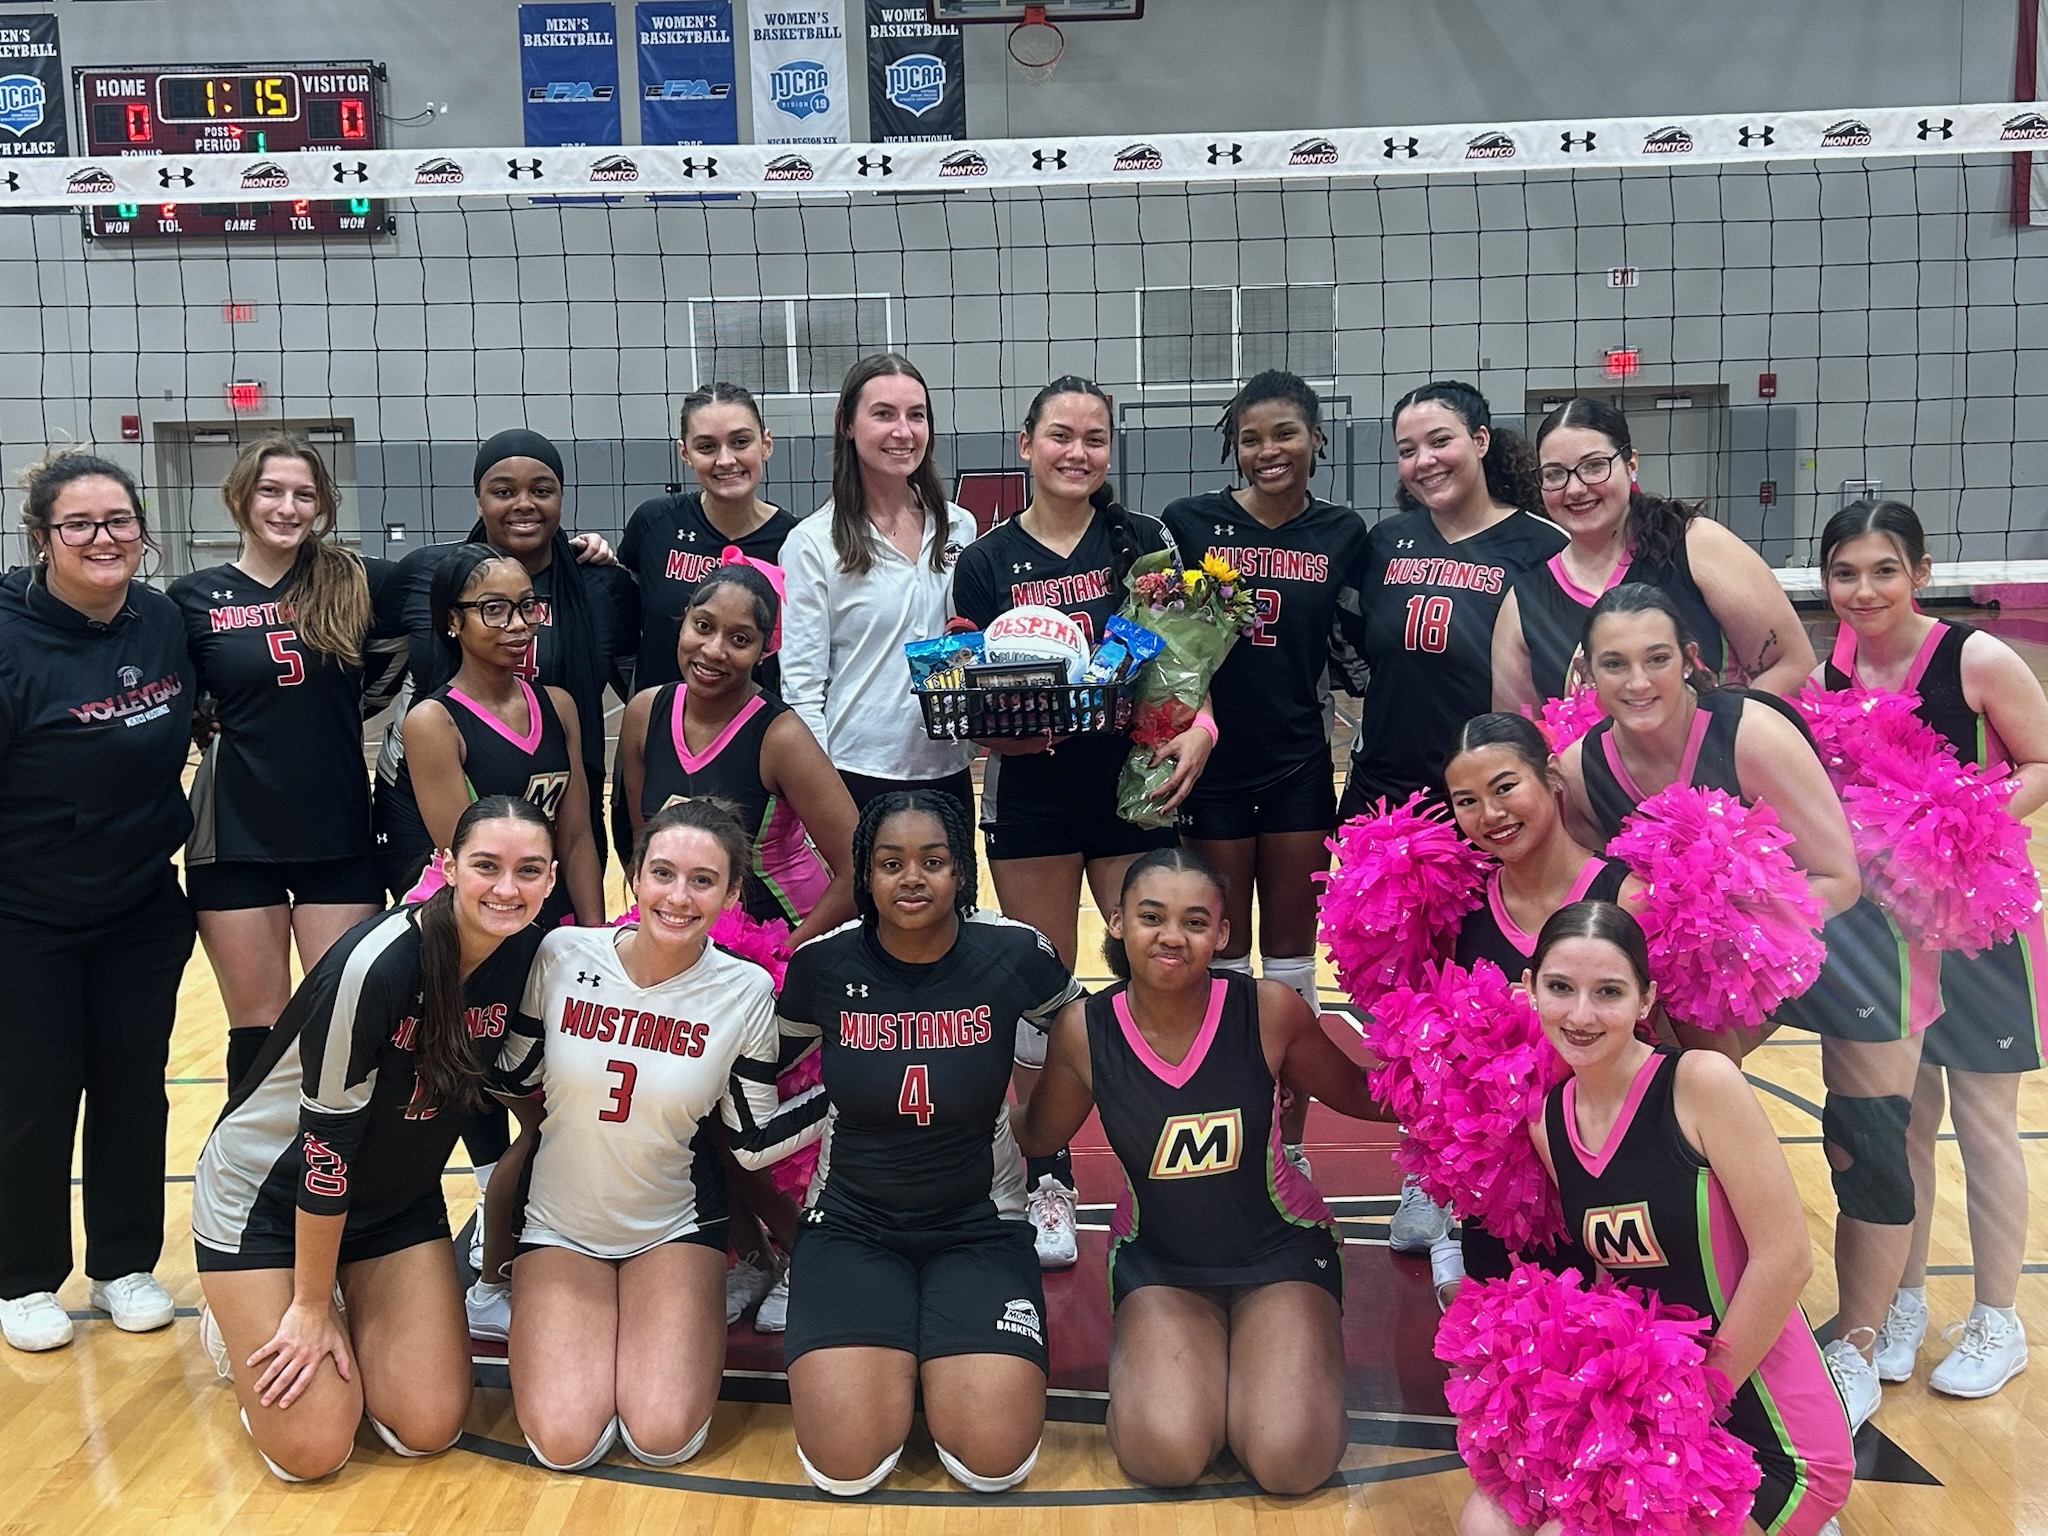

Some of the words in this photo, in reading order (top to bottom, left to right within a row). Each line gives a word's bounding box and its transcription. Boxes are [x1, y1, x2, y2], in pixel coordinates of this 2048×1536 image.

[652, 15, 717, 29] WOMEN'S
[765, 12, 829, 25] WOMEN'S
[881, 8, 928, 22] WOME
[546, 19, 589, 31] MEN'S
[870, 24, 959, 38] BASKETBALL
[524, 33, 613, 46] BASKETBALL
[641, 30, 730, 44] BASKETBALL
[754, 27, 842, 40] BASKETBALL
[96, 79, 146, 97] HOME
[302, 75, 369, 93] VISITOR
[770, 71, 828, 100] NJCAA
[888, 66, 944, 95] NJCAA
[528, 82, 615, 100] EPAC
[645, 80, 731, 99] EPAC
[206, 79, 288, 117] 1:15
[814, 99, 827, 109] 19
[126, 103, 151, 142] 0
[340, 100, 365, 138] 0
[204, 127, 229, 137] POSS
[194, 138, 241, 152] PERIOD
[1642, 139, 1694, 154] MONTCO
[1820, 132, 1871, 148] MONTCO
[13, 142, 56, 154] PLACE
[1465, 145, 1516, 160] MONTCO
[1113, 157, 1163, 171] MONTCO
[1288, 152, 1339, 166] MONTCO
[414, 170, 464, 184] MONTCO
[589, 168, 639, 182] MONTCO
[764, 168, 814, 181] MONTCO
[938, 163, 988, 177] MONTCO
[66, 181, 115, 194] MONTCO
[241, 177, 289, 189] MONTCO
[105, 222, 130, 233] WON
[225, 219, 257, 231] GAME
[290, 217, 316, 230] TOL
[340, 217, 366, 229] WON
[1612, 268, 1635, 286] EXIT
[225, 302, 253, 321] EXIT
[1208, 546, 1329, 583] MUSTANGS
[1384, 558, 1505, 594] MUSTANGS
[1252, 588, 1281, 647] 2
[1405, 594, 1453, 653] 18
[991, 616, 1080, 649] DESPINA
[265, 630, 305, 687] 5
[560, 997, 710, 1058] MUSTANGS
[840, 1005, 992, 1050] MUSTANGS
[598, 1059, 638, 1123] 3
[898, 1064, 934, 1126] 4
[1007, 1310, 1039, 1330] MONTCO
